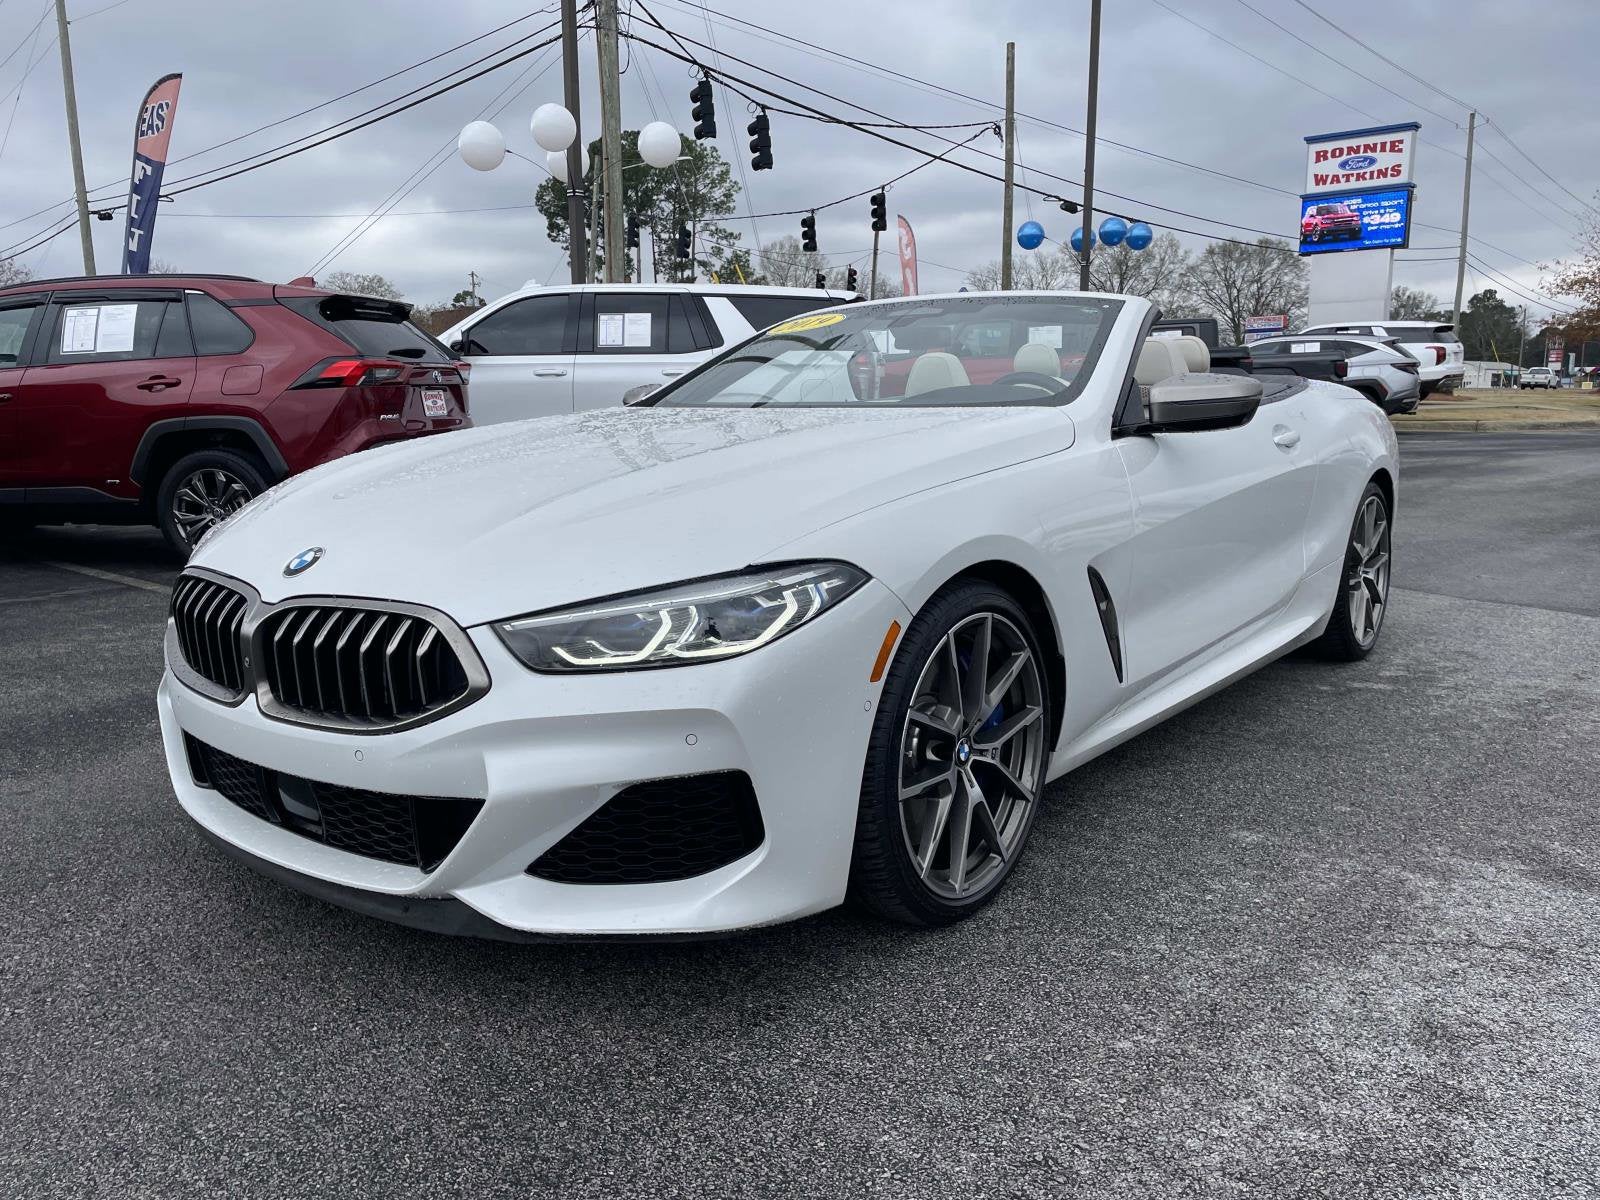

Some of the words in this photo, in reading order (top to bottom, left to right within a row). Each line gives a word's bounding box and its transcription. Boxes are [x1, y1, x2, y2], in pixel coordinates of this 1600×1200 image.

[139, 101, 171, 139] EAS
[1315, 139, 1404, 164] RONNIE
[1313, 163, 1402, 186] WATKINS
[1345, 158, 1370, 169] Ford
[1362, 212, 1401, 224] $349
